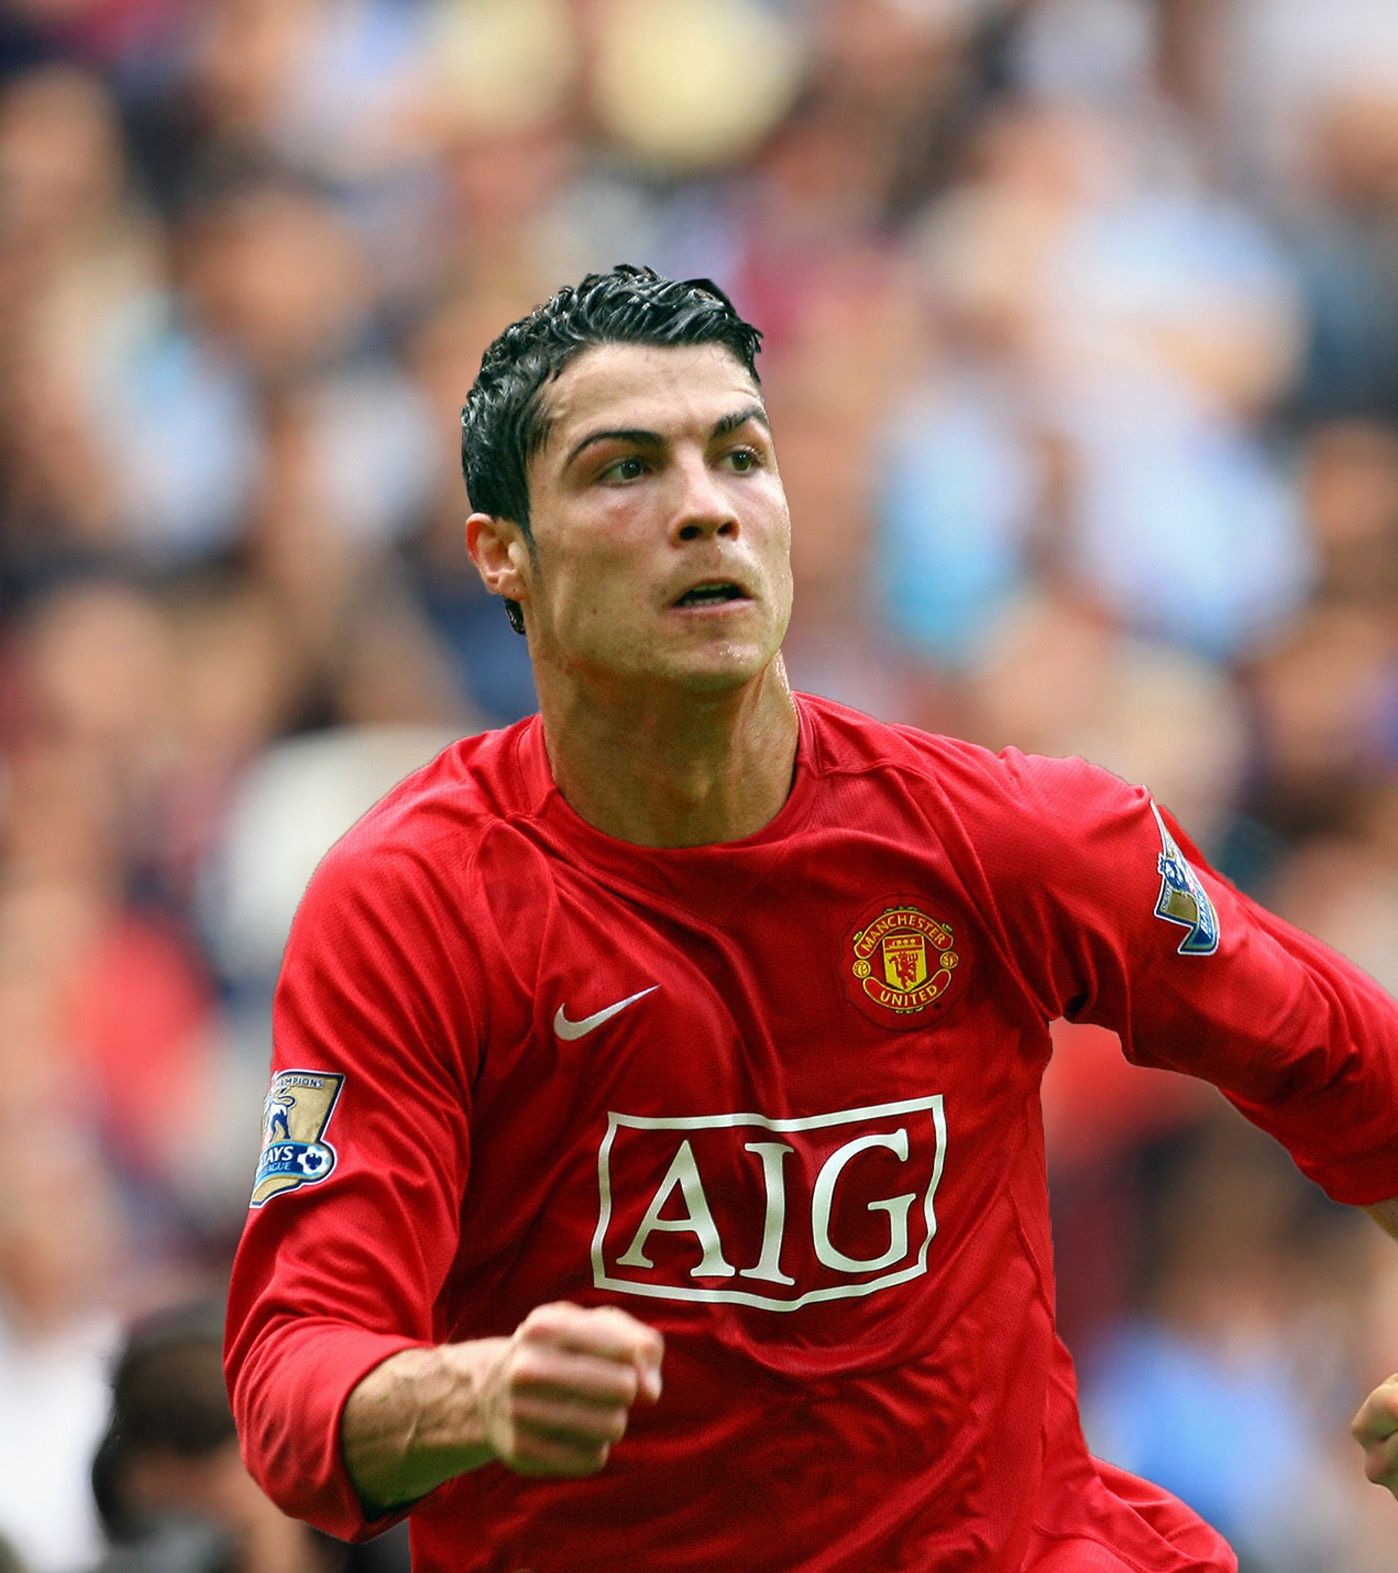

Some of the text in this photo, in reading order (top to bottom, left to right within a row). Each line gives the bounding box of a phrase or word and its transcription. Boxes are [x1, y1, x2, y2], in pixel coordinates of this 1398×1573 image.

[860, 914, 946, 953] MANCHESTER
[880, 985, 937, 1007] UNITED
[615, 1128, 917, 1287] AIG
